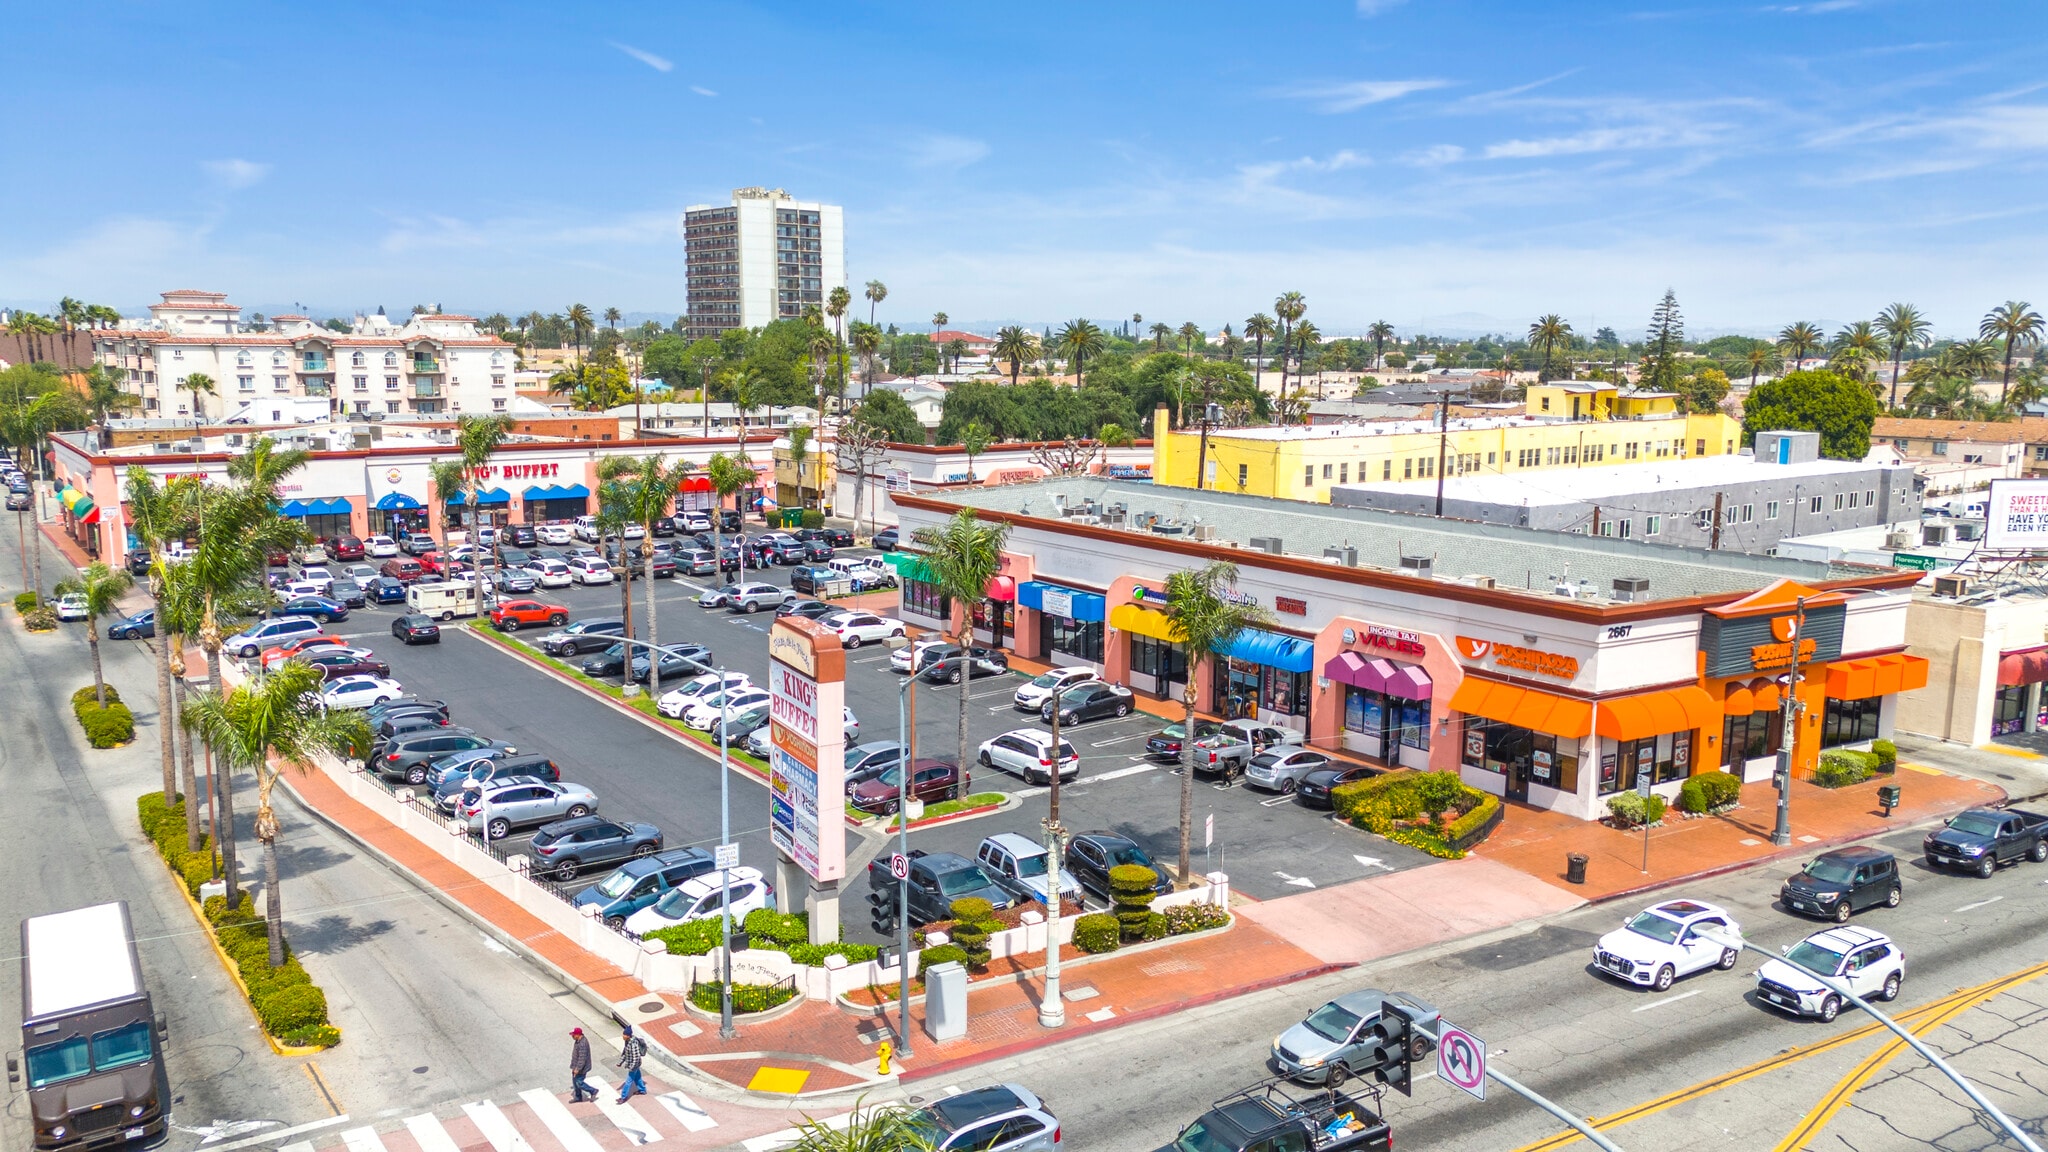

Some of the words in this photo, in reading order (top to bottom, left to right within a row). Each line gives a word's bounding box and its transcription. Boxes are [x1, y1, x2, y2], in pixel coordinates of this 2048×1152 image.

[503, 463, 559, 479] BUFFET
[1110, 470, 1150, 478] PHARMACY
[2010, 495, 2048, 505] SWEET
[2007, 514, 2034, 523] HAVE
[2007, 524, 2033, 532] EATEN
[1894, 555, 1923, 564] Florence
[1369, 626, 1399, 638] INCOME
[1401, 631, 1417, 641] TAX
[1608, 624, 1633, 639] 2667
[1359, 632, 1426, 657] VIAJES
[1491, 642, 1579, 673] YOSHINOYA
[782, 670, 818, 708] KING'S
[772, 693, 818, 738] BUFFET
[1468, 741, 1482, 755] $3
[1675, 748, 1687, 762] $3
[787, 756, 813, 779] CAMERON
[782, 761, 818, 796] PHARMACY
[736, 962, 746, 971] de
[747, 963, 755, 971] la
[755, 965, 781, 982] Fiesta
